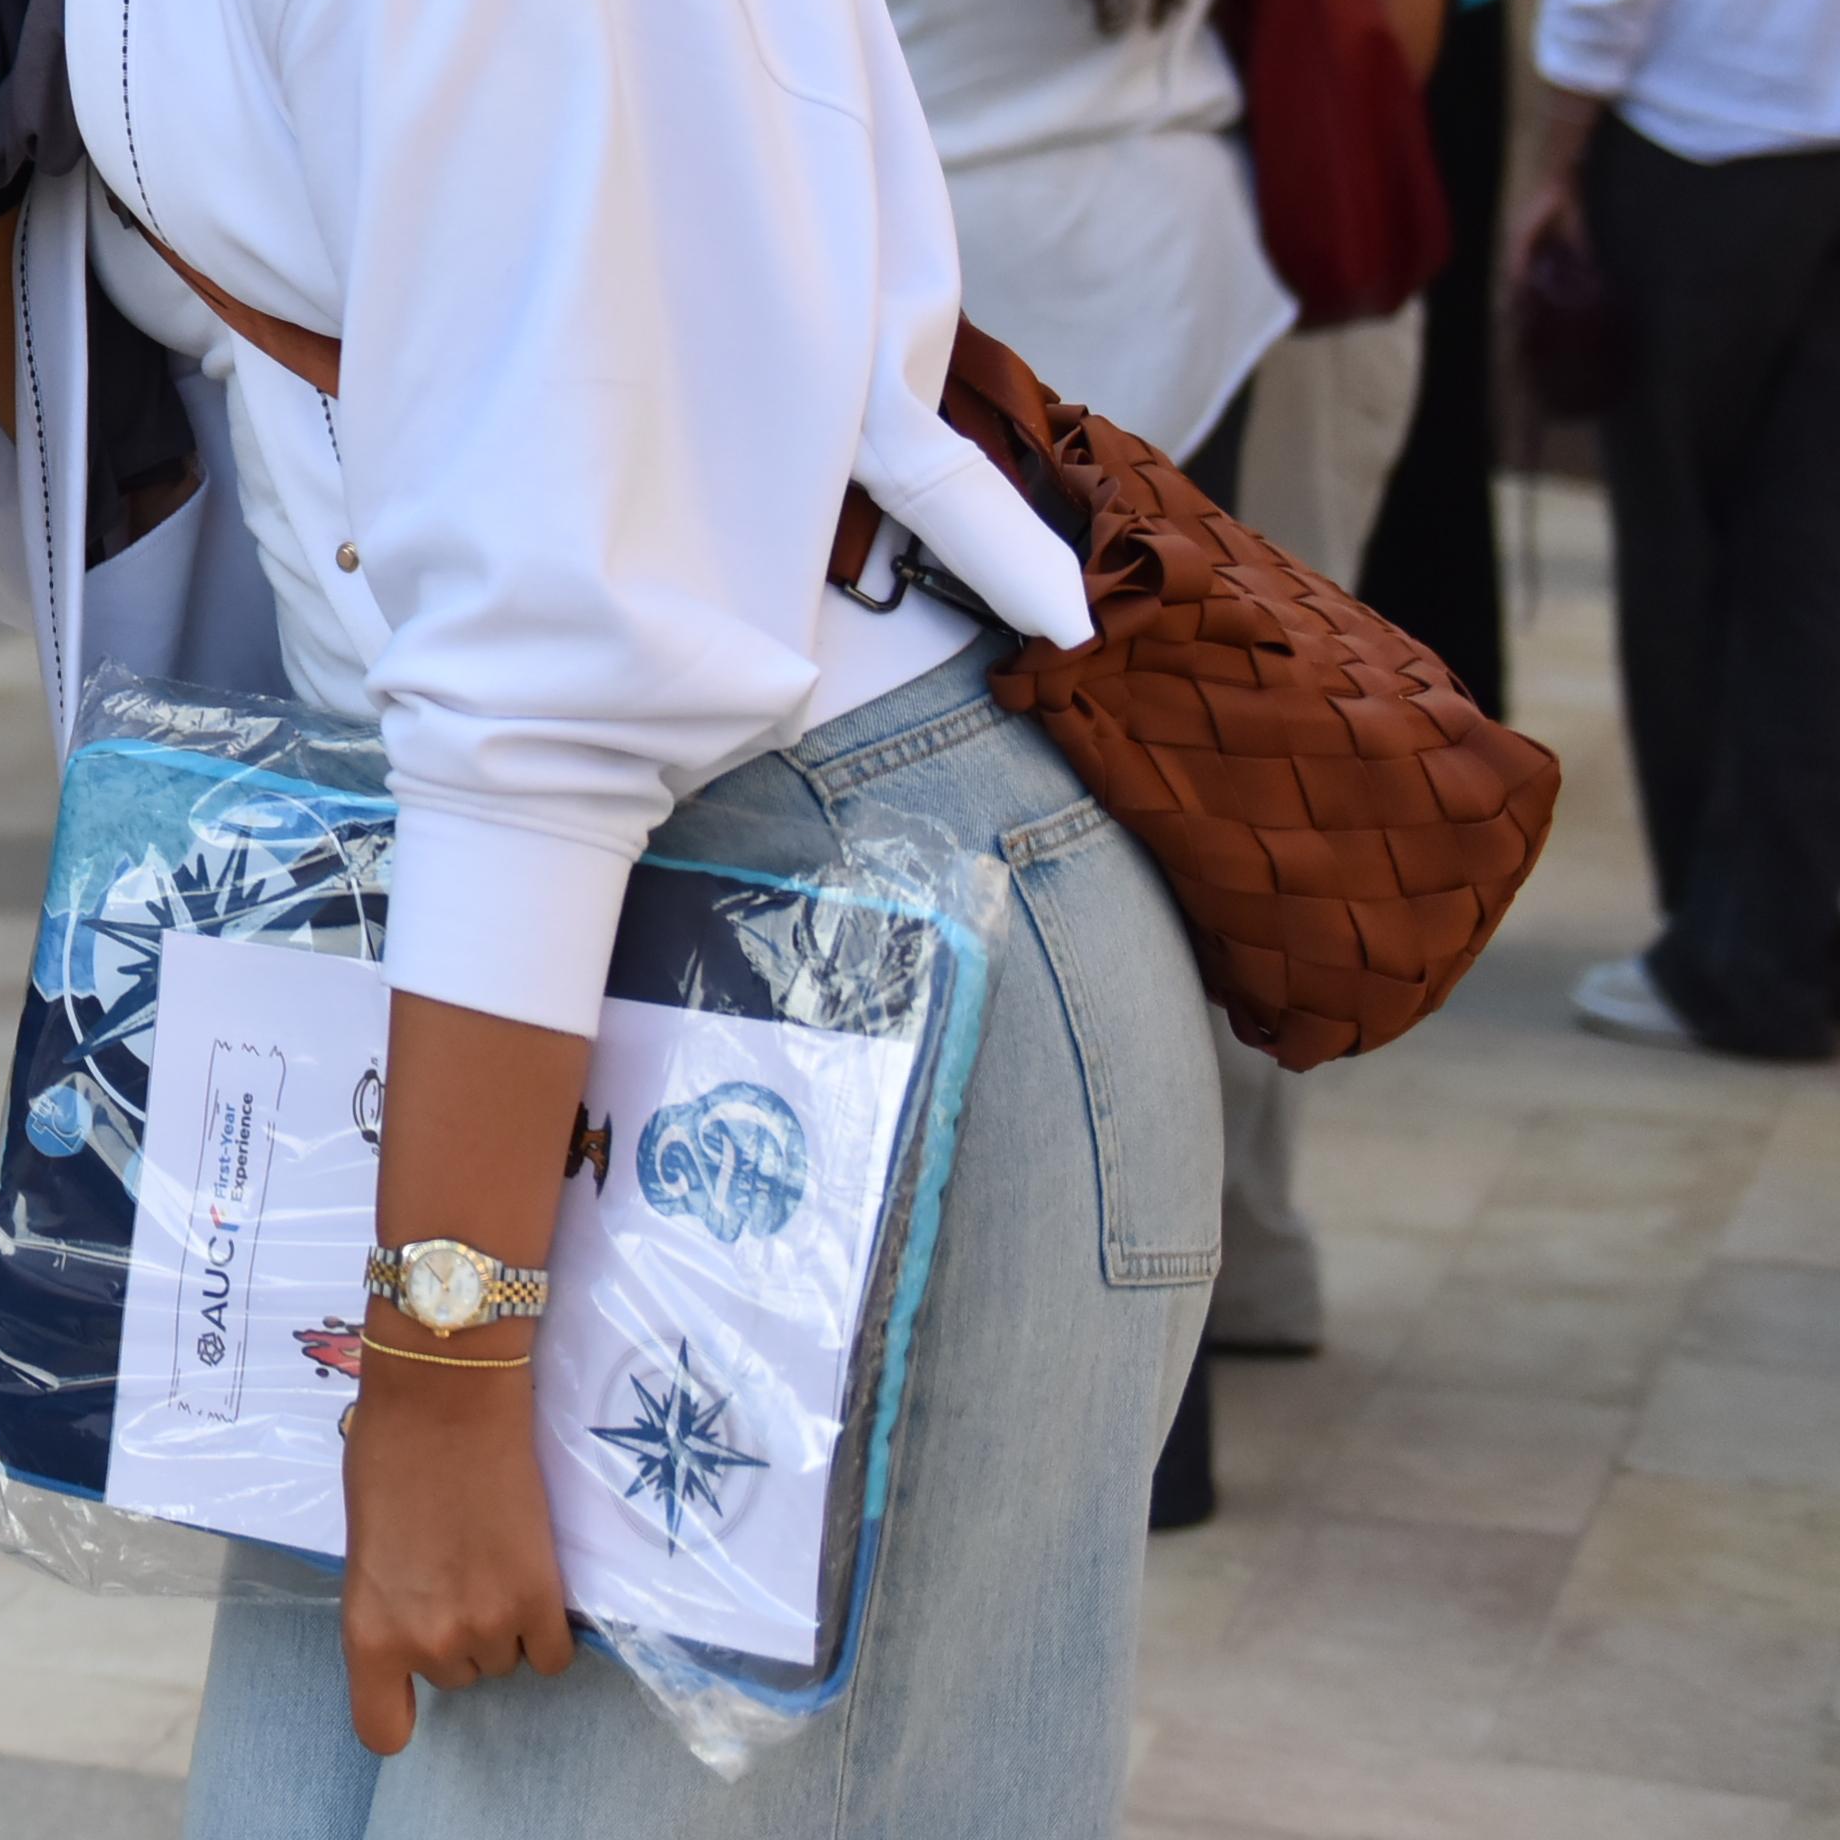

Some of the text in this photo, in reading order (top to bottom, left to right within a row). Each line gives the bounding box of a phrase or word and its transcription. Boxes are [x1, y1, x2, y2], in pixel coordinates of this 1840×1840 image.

[213, 1101, 237, 1200] First-Year
[230, 1091, 254, 1204] Experience
[201, 1235, 236, 1333] AUC
